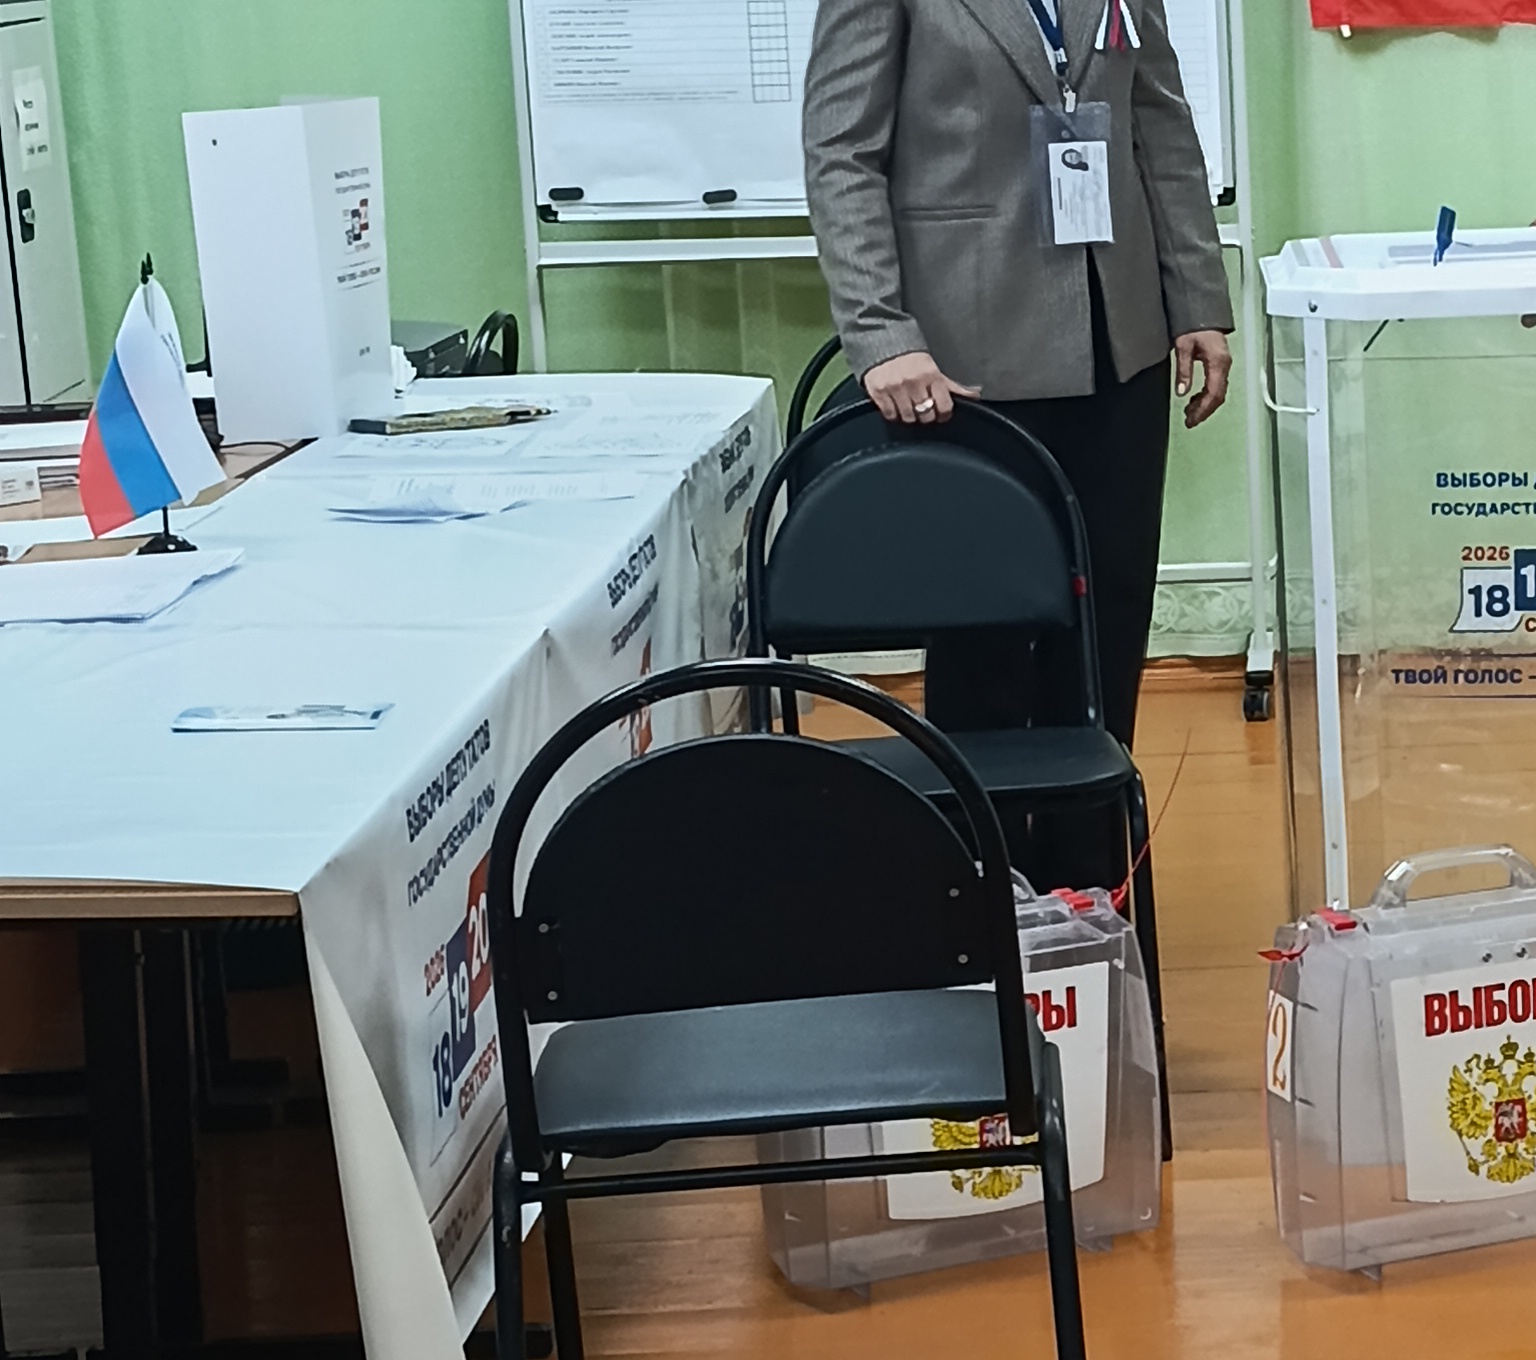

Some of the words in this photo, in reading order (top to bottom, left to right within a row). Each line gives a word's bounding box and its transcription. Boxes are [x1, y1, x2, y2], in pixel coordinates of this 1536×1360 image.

[1436, 471, 1529, 489] ВЫБОРЫ
[1461, 546, 1511, 561] 2026
[1468, 584, 1511, 618] 18
[1391, 665, 1448, 685] ТВОЙ
[1454, 668, 1524, 685] ГОЛОС
[433, 1030, 451, 1119] 18
[452, 960, 470, 1042] 19
[468, 892, 490, 982] 20
[1272, 1001, 1288, 1092] 2
